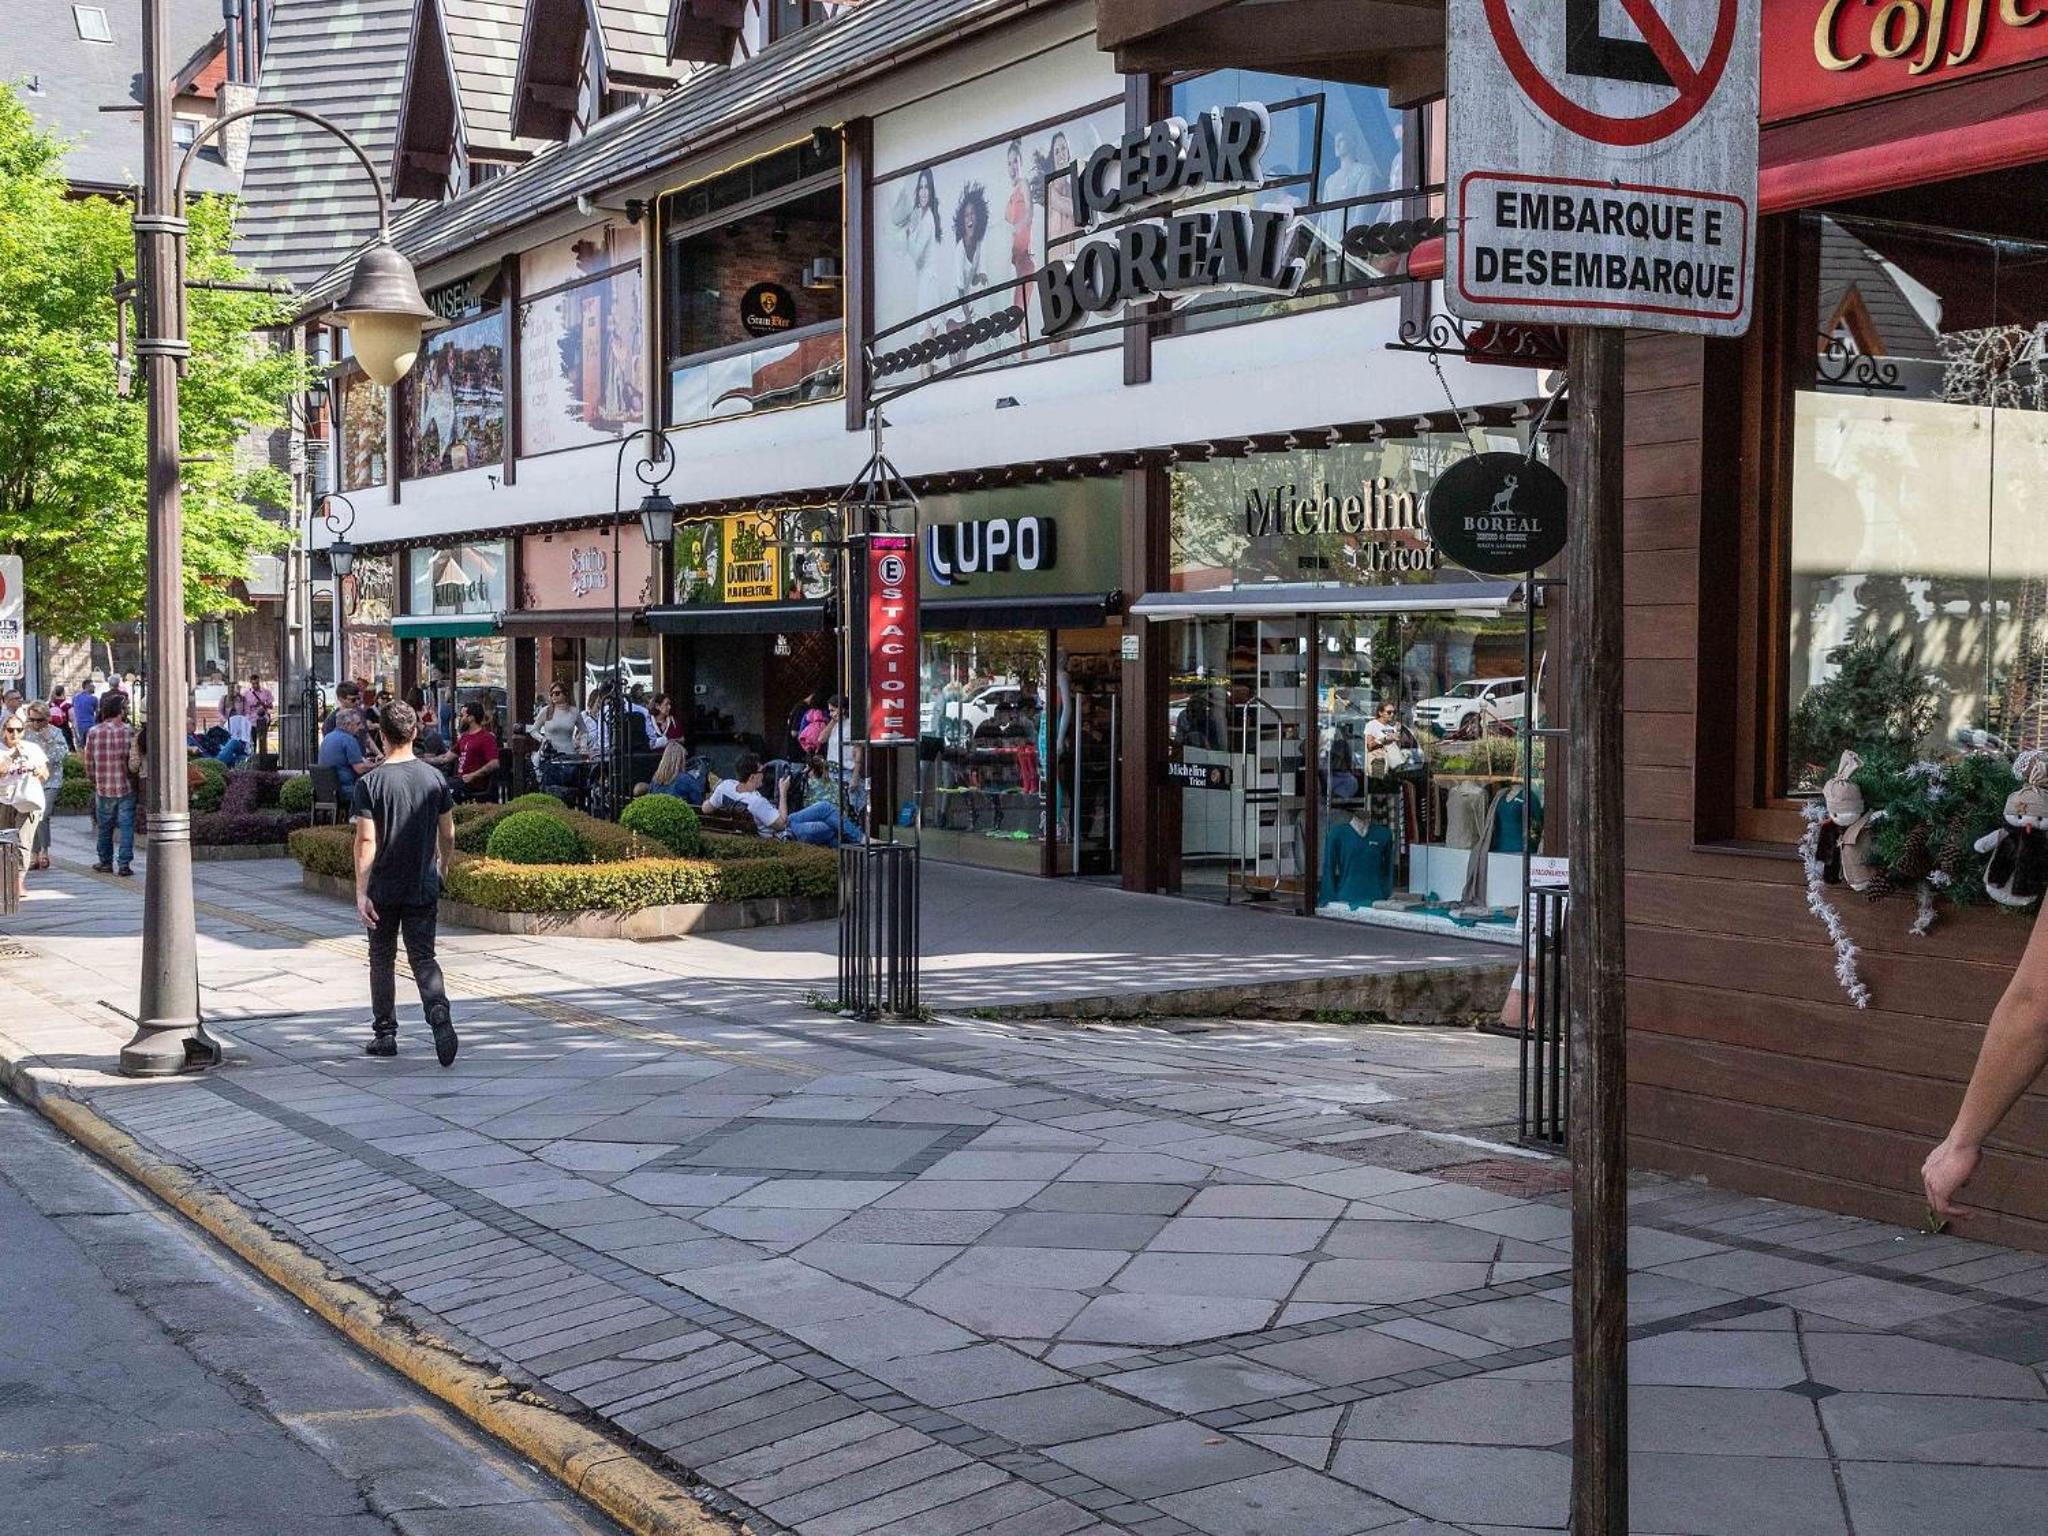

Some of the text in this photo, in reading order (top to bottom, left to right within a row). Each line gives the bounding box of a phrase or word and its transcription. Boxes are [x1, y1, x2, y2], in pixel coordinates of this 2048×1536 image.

[1070, 103, 1266, 228] ICEBAR
[1496, 191, 1722, 245] EMBARQUE E
[1038, 207, 1305, 336] BOREAL
[1475, 246, 1734, 301] DESEMBARQUE
[928, 516, 1040, 585] LUPO
[1464, 517, 1542, 532] BOREAL
[1363, 541, 1435, 572] Tricot
